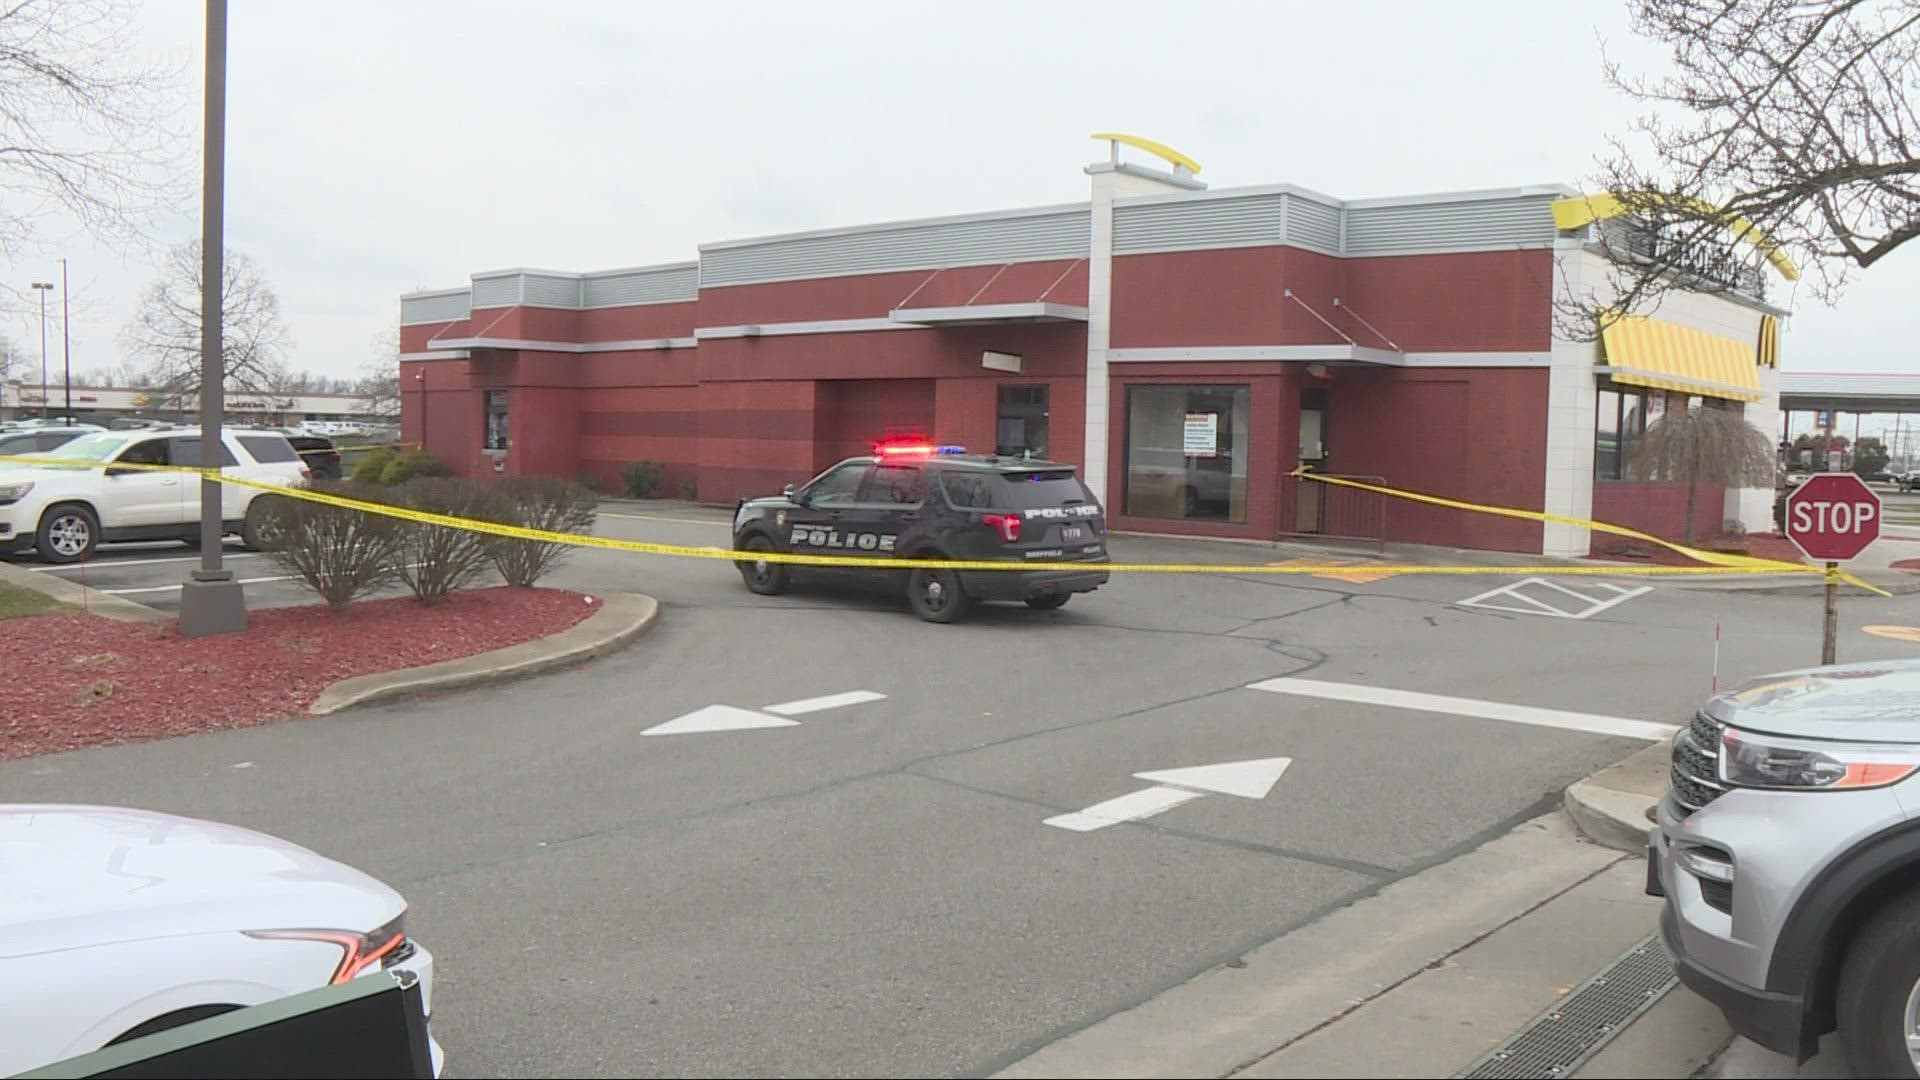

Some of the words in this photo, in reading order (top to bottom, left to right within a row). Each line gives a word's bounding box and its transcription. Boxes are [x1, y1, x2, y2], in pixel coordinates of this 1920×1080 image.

[1024, 505, 1100, 519] POLICE
[1792, 501, 1875, 534] STOP
[789, 529, 897, 551] POLICE
